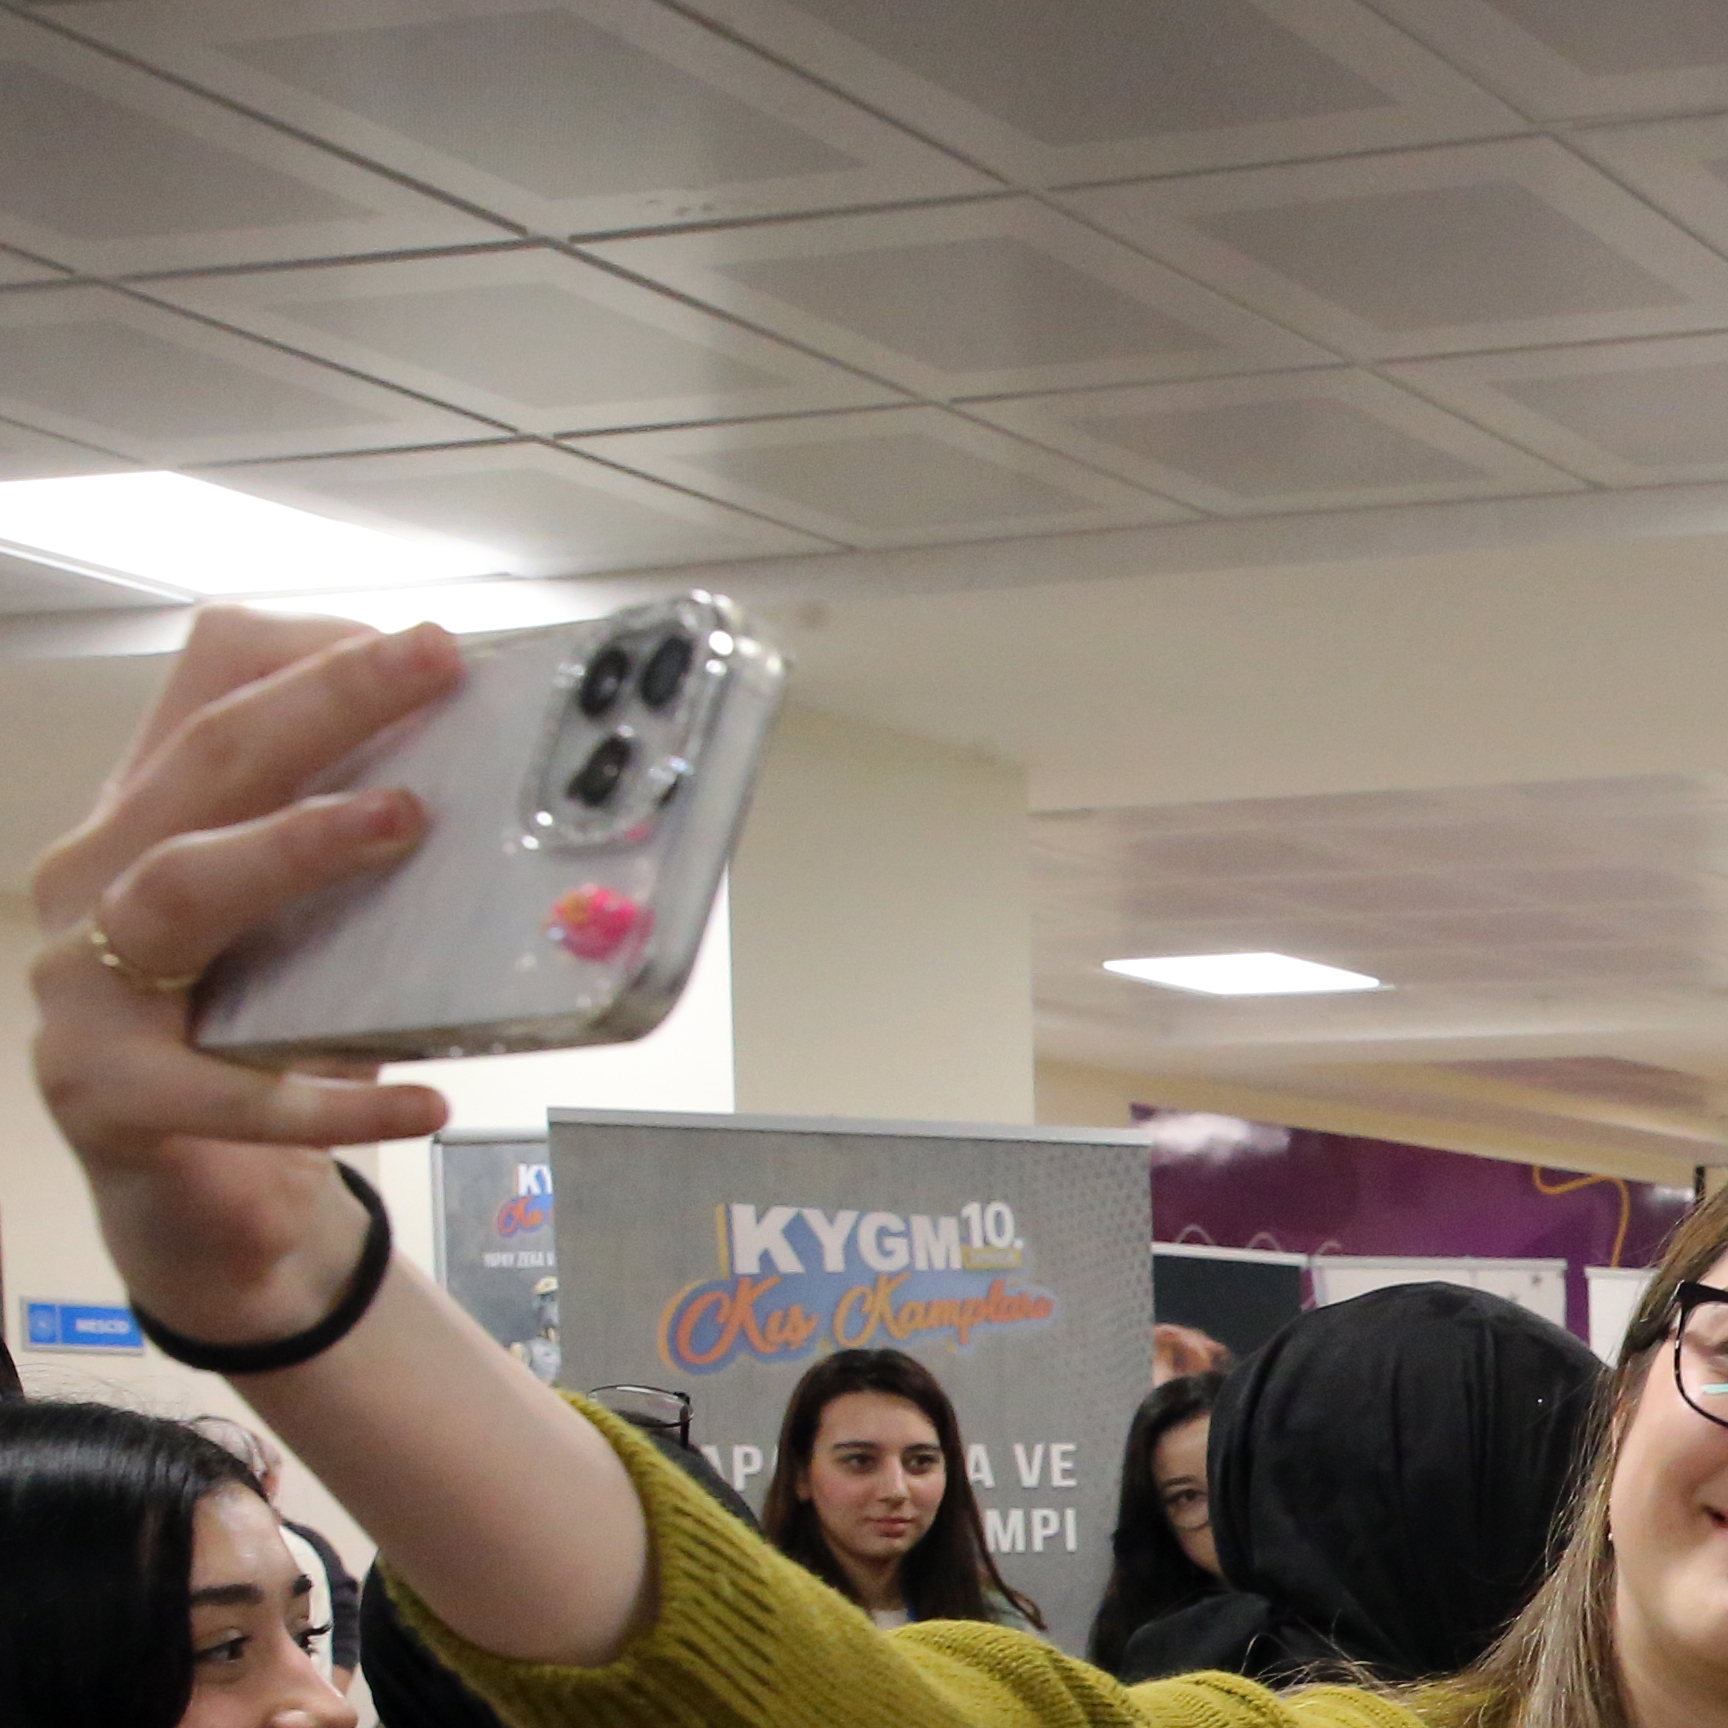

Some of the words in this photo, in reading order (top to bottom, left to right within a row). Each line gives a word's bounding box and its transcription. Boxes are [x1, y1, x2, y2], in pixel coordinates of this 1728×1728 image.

[731, 1202, 961, 1275] KYGM
[1014, 1442, 1078, 1489] VE
[986, 1507, 1078, 1554] MPI
